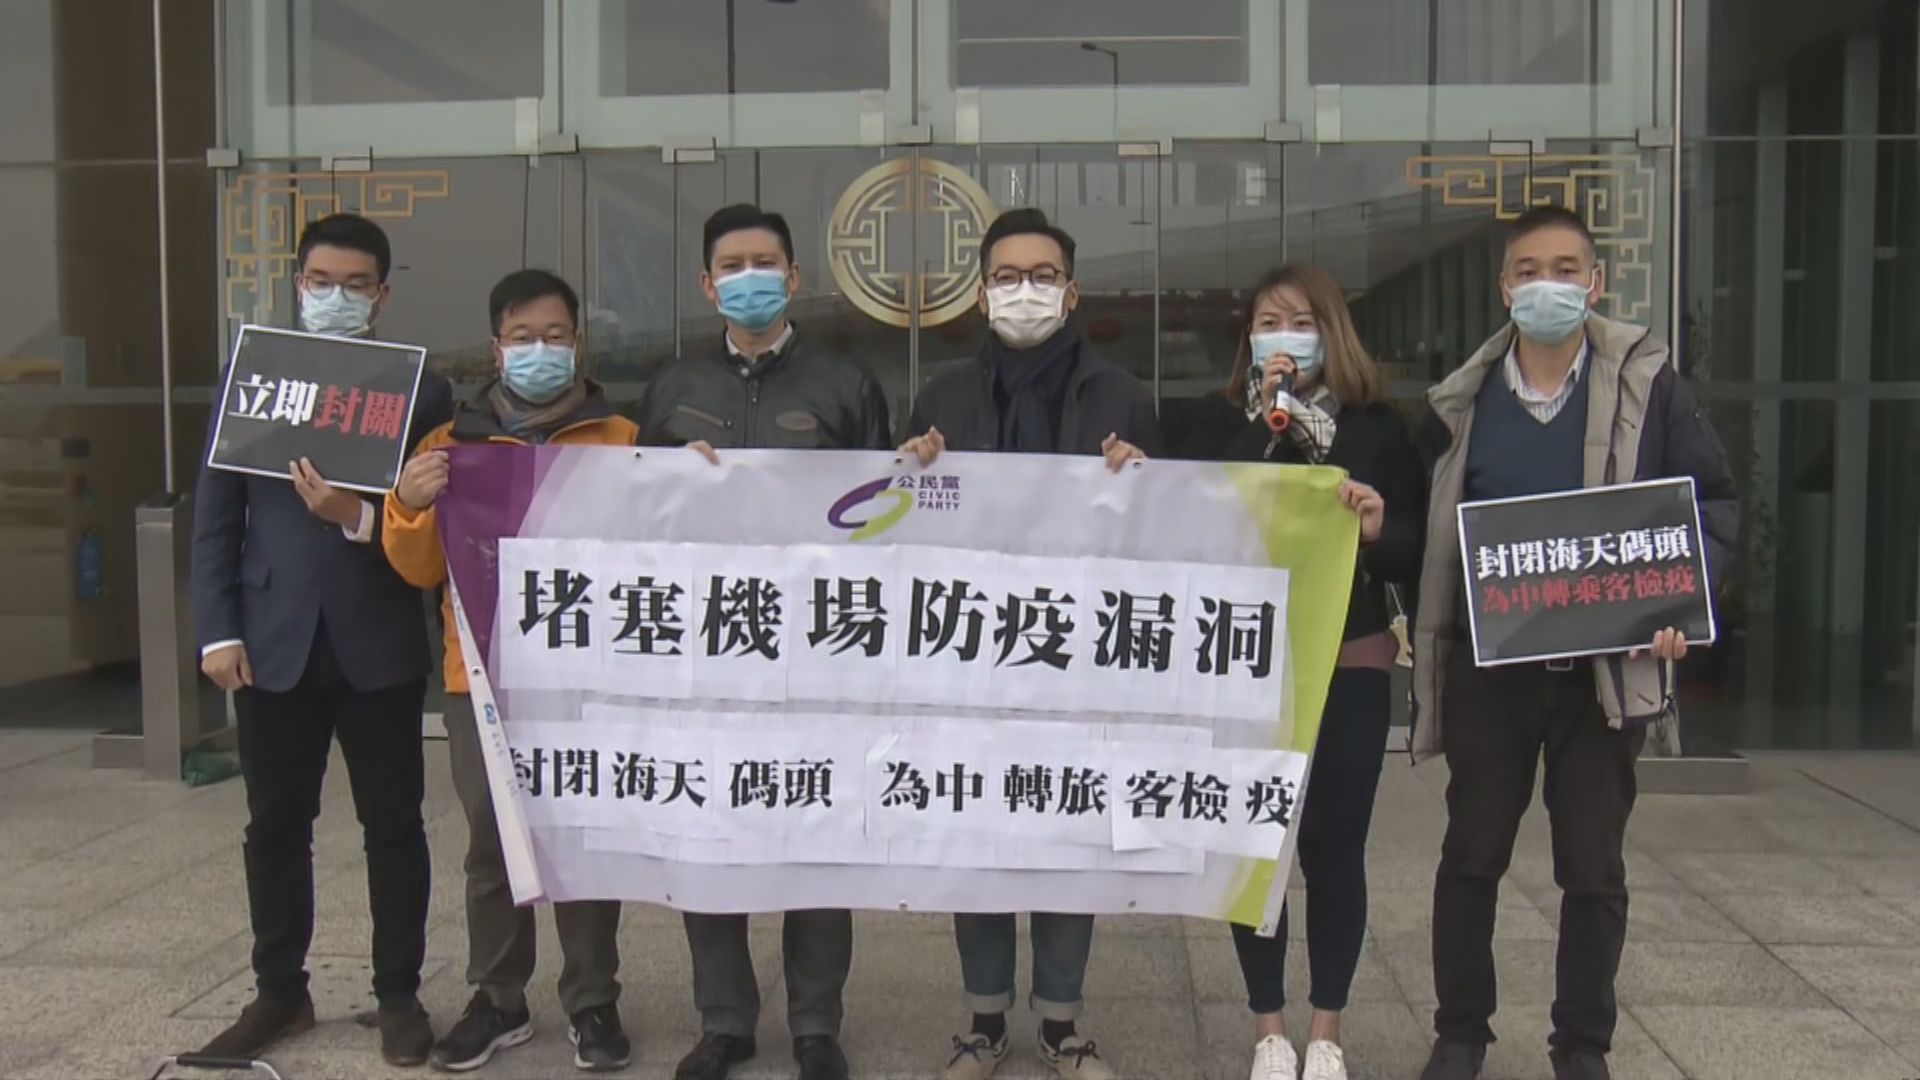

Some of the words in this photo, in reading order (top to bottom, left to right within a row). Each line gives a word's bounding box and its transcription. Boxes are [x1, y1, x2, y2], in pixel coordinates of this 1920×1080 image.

[229, 374, 405, 439] 立即封關
[898, 475, 960, 489] 公民黨
[918, 491, 961, 500] CIVIC
[918, 502, 960, 510] PARTY
[1476, 524, 1691, 580] 封閉海天碼頭
[1483, 565, 1695, 615] 為中轉乘客檢疫
[518, 568, 1276, 679] 堵塞機場防疫漏洞
[880, 762, 1296, 825] 為中轉旅客檢疫
